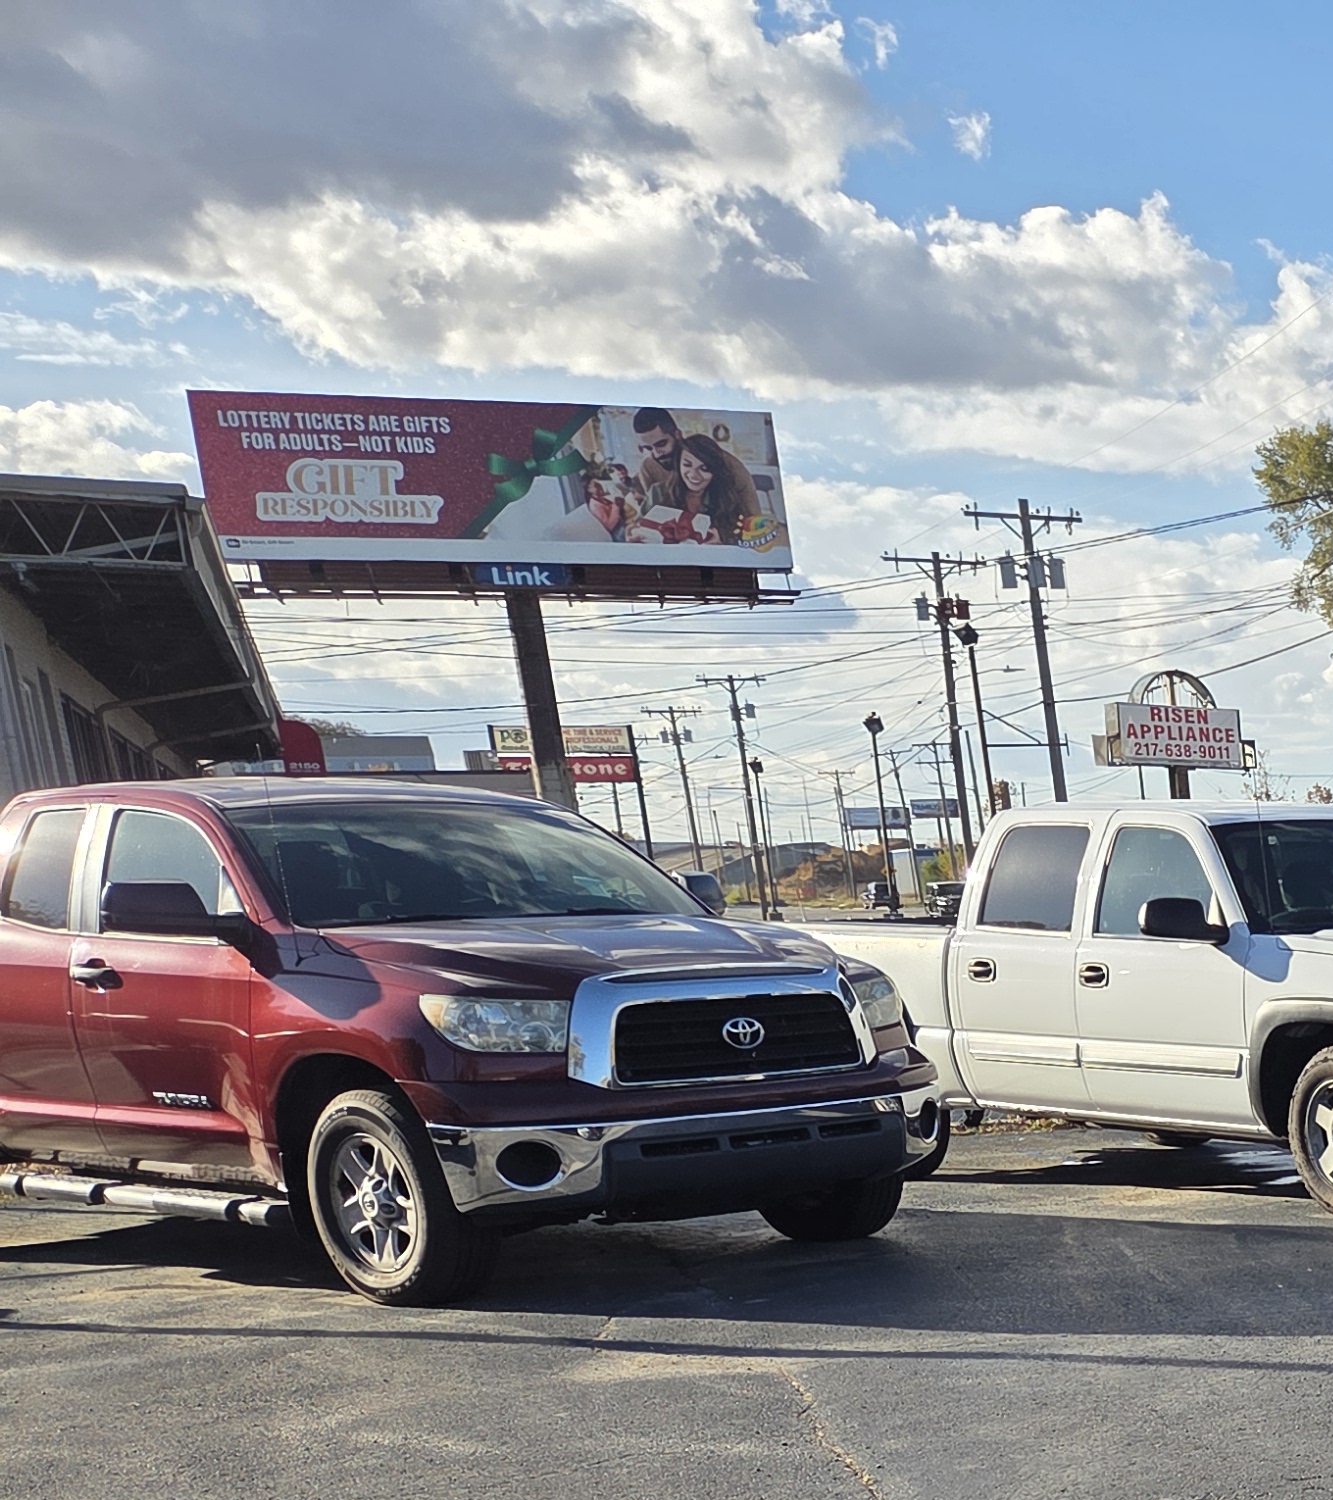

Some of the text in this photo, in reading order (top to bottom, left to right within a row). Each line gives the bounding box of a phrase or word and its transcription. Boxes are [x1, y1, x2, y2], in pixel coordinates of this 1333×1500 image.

[217, 409, 451, 434] LOTTERY TICKETS ARE GIFTS
[240, 431, 276, 450] FOR
[395, 436, 436, 454] KIDS
[292, 462, 399, 497] GIFT
[261, 496, 439, 519] RESPONSIBLY
[490, 565, 552, 586] Link
[1150, 706, 1209, 725] RISEN
[1126, 723, 1236, 744] APPLIANCE
[1133, 741, 1231, 760] 217-638-9011
[504, 761, 628, 776] Ftone
